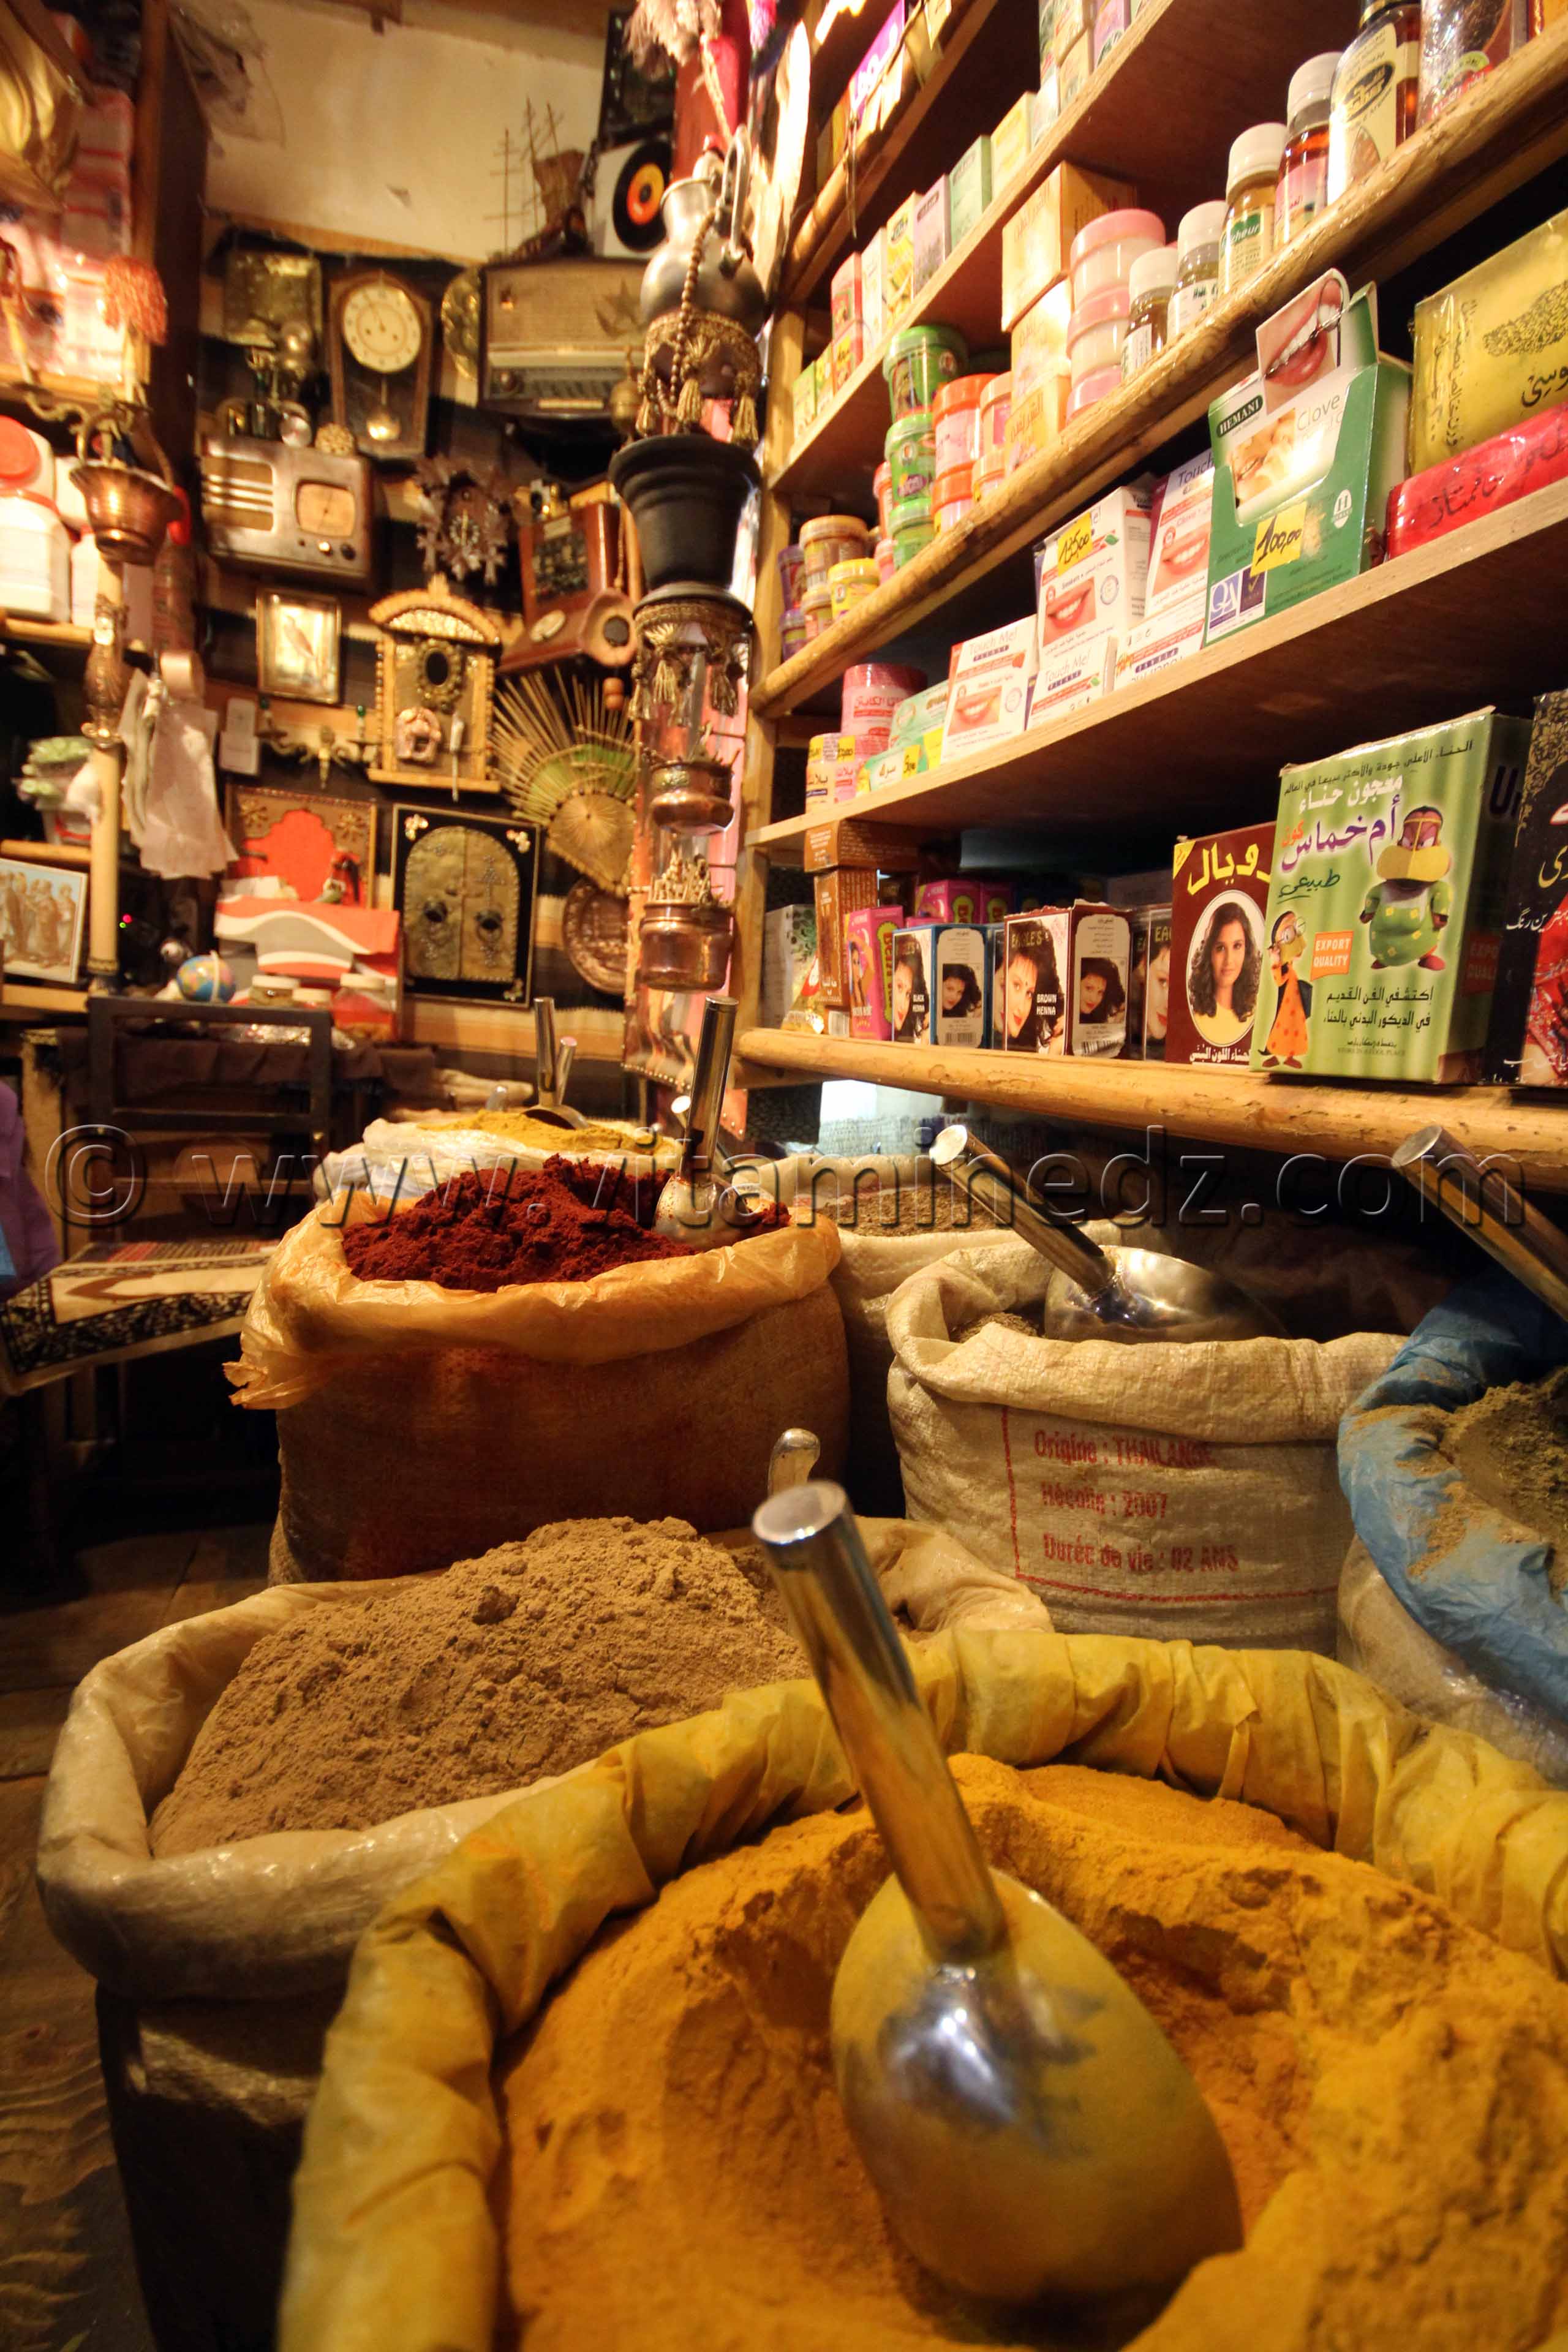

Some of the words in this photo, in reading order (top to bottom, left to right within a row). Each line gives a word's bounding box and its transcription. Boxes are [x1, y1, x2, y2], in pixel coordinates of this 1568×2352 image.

[1219, 401, 1260, 434] HEMANI
[1297, 394, 1341, 432] Clove
[1298, 783, 1343, 814] حناء
[1347, 774, 1404, 807] معجون
[1281, 815, 1368, 872] خماس
[1369, 794, 1401, 866] أم
[1315, 938, 1351, 951] EXPORT
[1313, 955, 1348, 967] QUALITY
[1036, 993, 1057, 1003] BROWN
[1327, 985, 1362, 1003] القديم
[1363, 986, 1385, 1005] الفن
[1036, 1006, 1057, 1016] HENNA
[1378, 1010, 1414, 1030] الديكور
[1415, 1011, 1431, 1033] في
[1035, 1430, 1098, 1464] Origine
[1122, 1490, 1167, 1518] 2007
[1043, 1533, 1095, 1564] Durée
[1101, 1543, 1122, 1568] de
[1127, 1544, 1153, 1572] vie
[1170, 1545, 1194, 1572] 02
[1199, 1544, 1239, 1572] ANS
